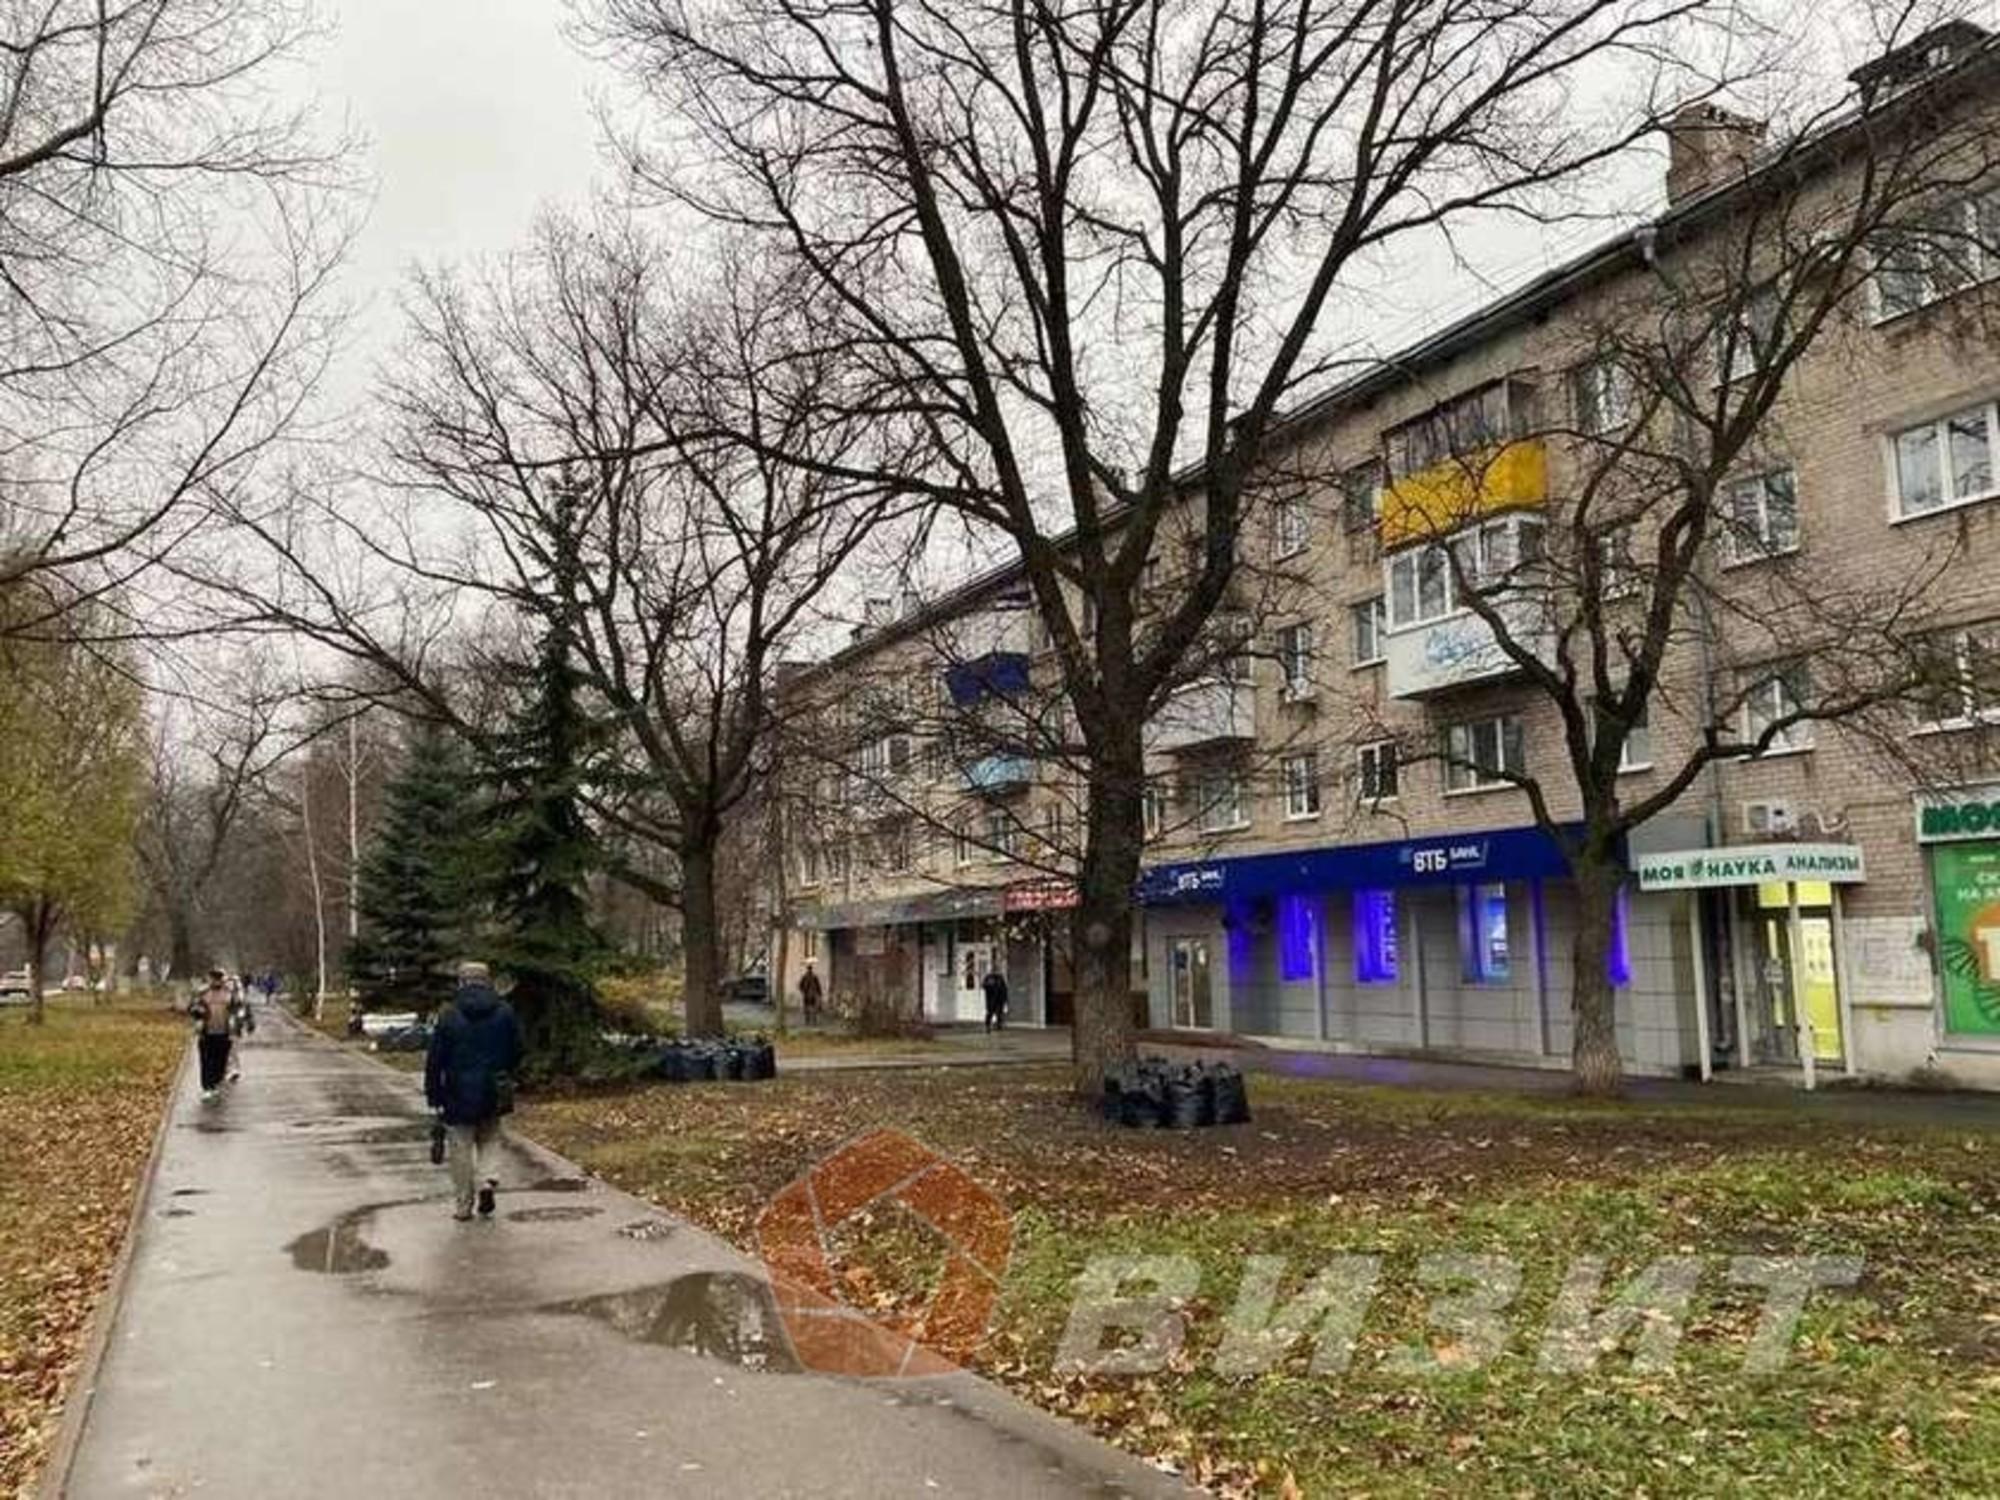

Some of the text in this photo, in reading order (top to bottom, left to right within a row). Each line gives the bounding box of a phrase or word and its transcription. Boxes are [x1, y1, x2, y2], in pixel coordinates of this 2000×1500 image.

[1414, 849, 1447, 873] ВТБ
[1642, 854, 1861, 882] МОЯ НАУКА АНАЛИЗЫ
